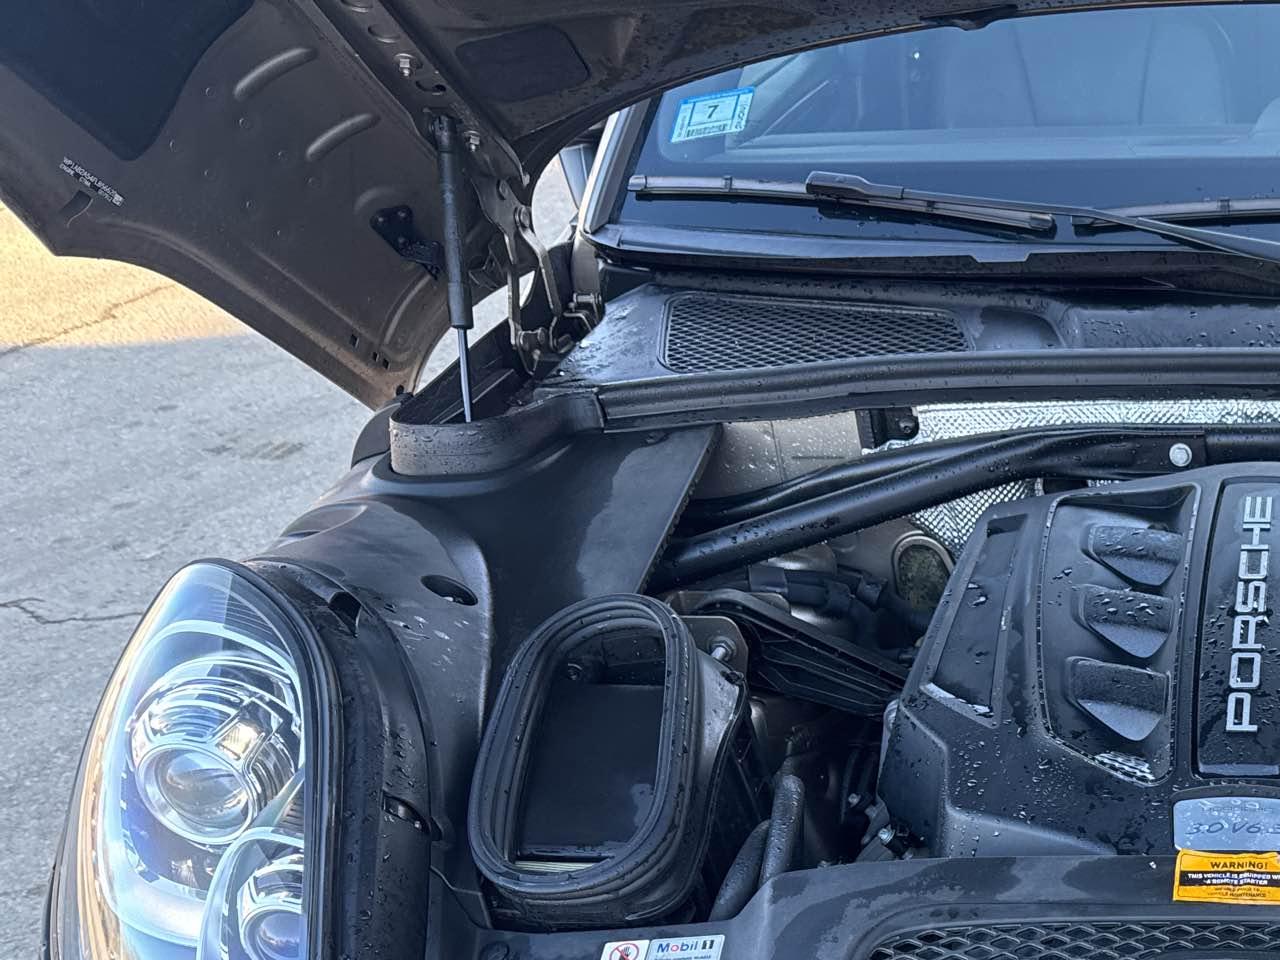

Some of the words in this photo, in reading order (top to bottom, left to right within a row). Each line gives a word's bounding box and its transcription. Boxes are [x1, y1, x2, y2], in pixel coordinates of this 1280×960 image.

[708, 104, 719, 119] 7
[1226, 497, 1273, 732] PORSCHE
[1210, 860, 1268, 870] WARNING!
[1204, 872, 1230, 880] VEHICLE
[1239, 872, 1271, 881] EQUIPPED
[656, 941, 698, 954] Mobil
